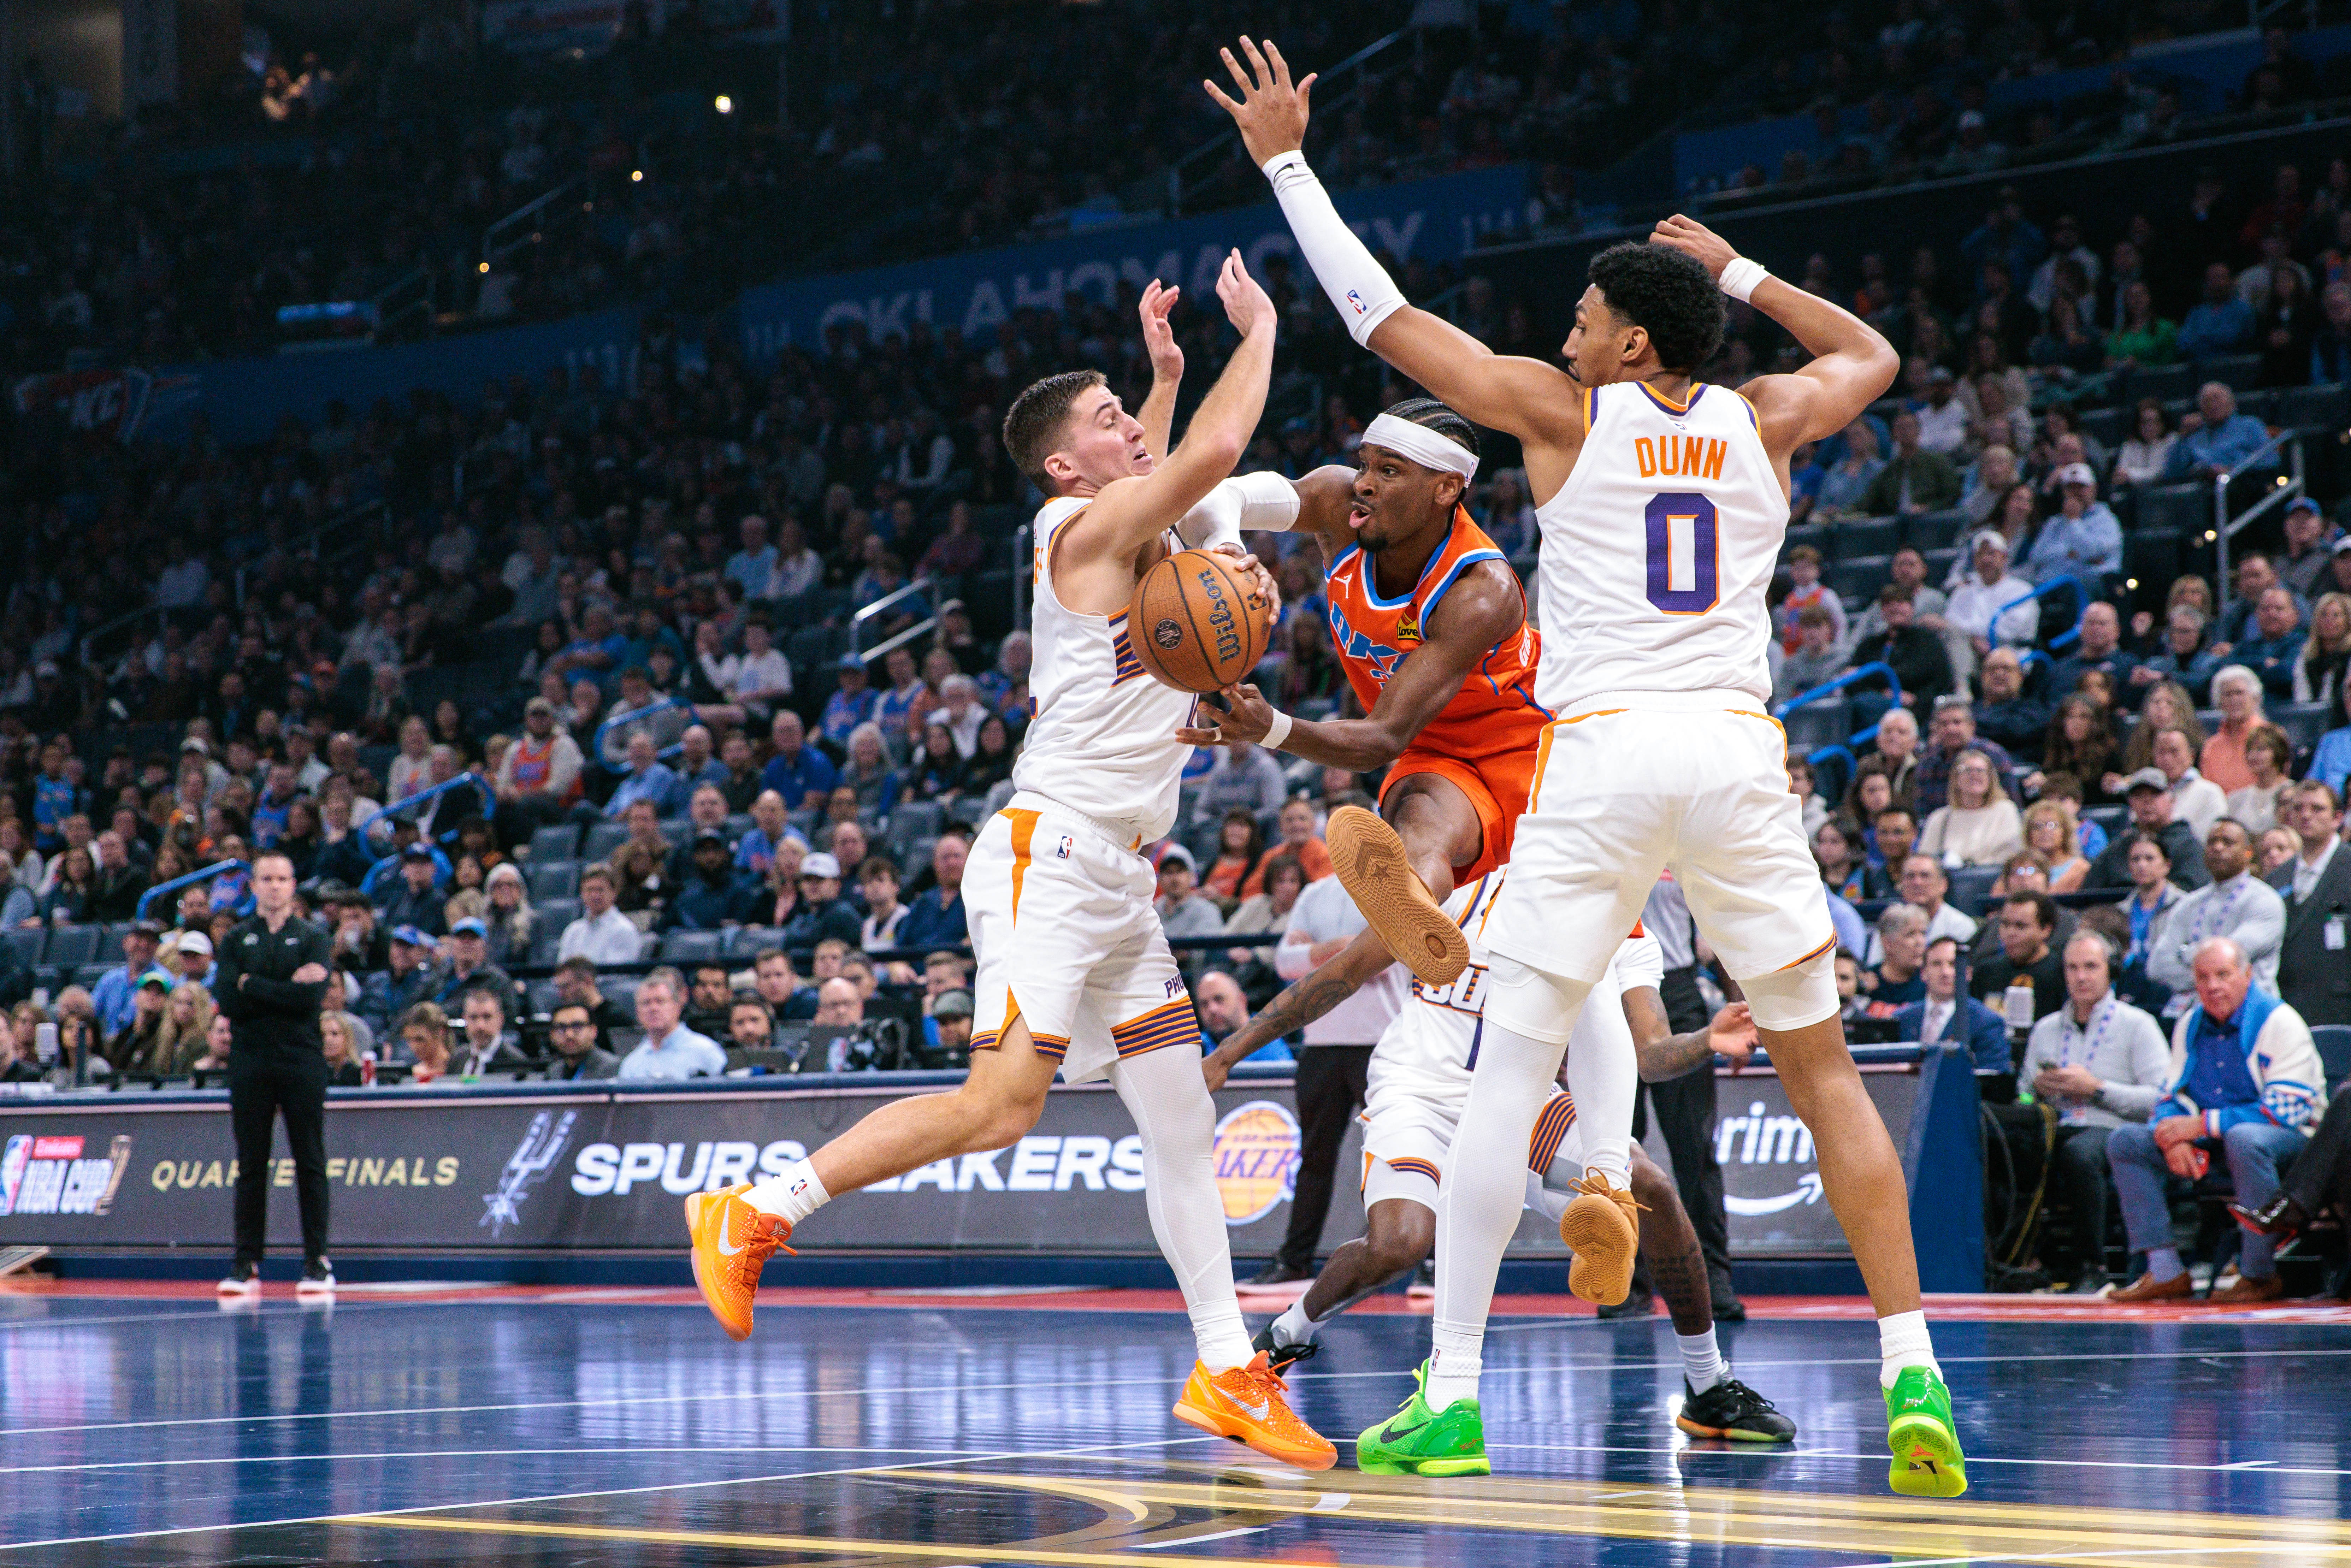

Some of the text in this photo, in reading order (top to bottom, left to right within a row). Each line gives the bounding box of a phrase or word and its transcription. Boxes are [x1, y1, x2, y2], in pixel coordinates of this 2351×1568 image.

[1635, 435, 1727, 480] DUNN
[1645, 493, 1719, 616] 0
[1197, 569, 1242, 665] Wilson
[1398, 627, 1420, 637] Love
[1714, 1101, 1818, 1164] rim
[151, 1157, 460, 1192] QUAEFINALS
[571, 1139, 808, 1196] SPURS
[862, 1135, 1146, 1194] AKERS
